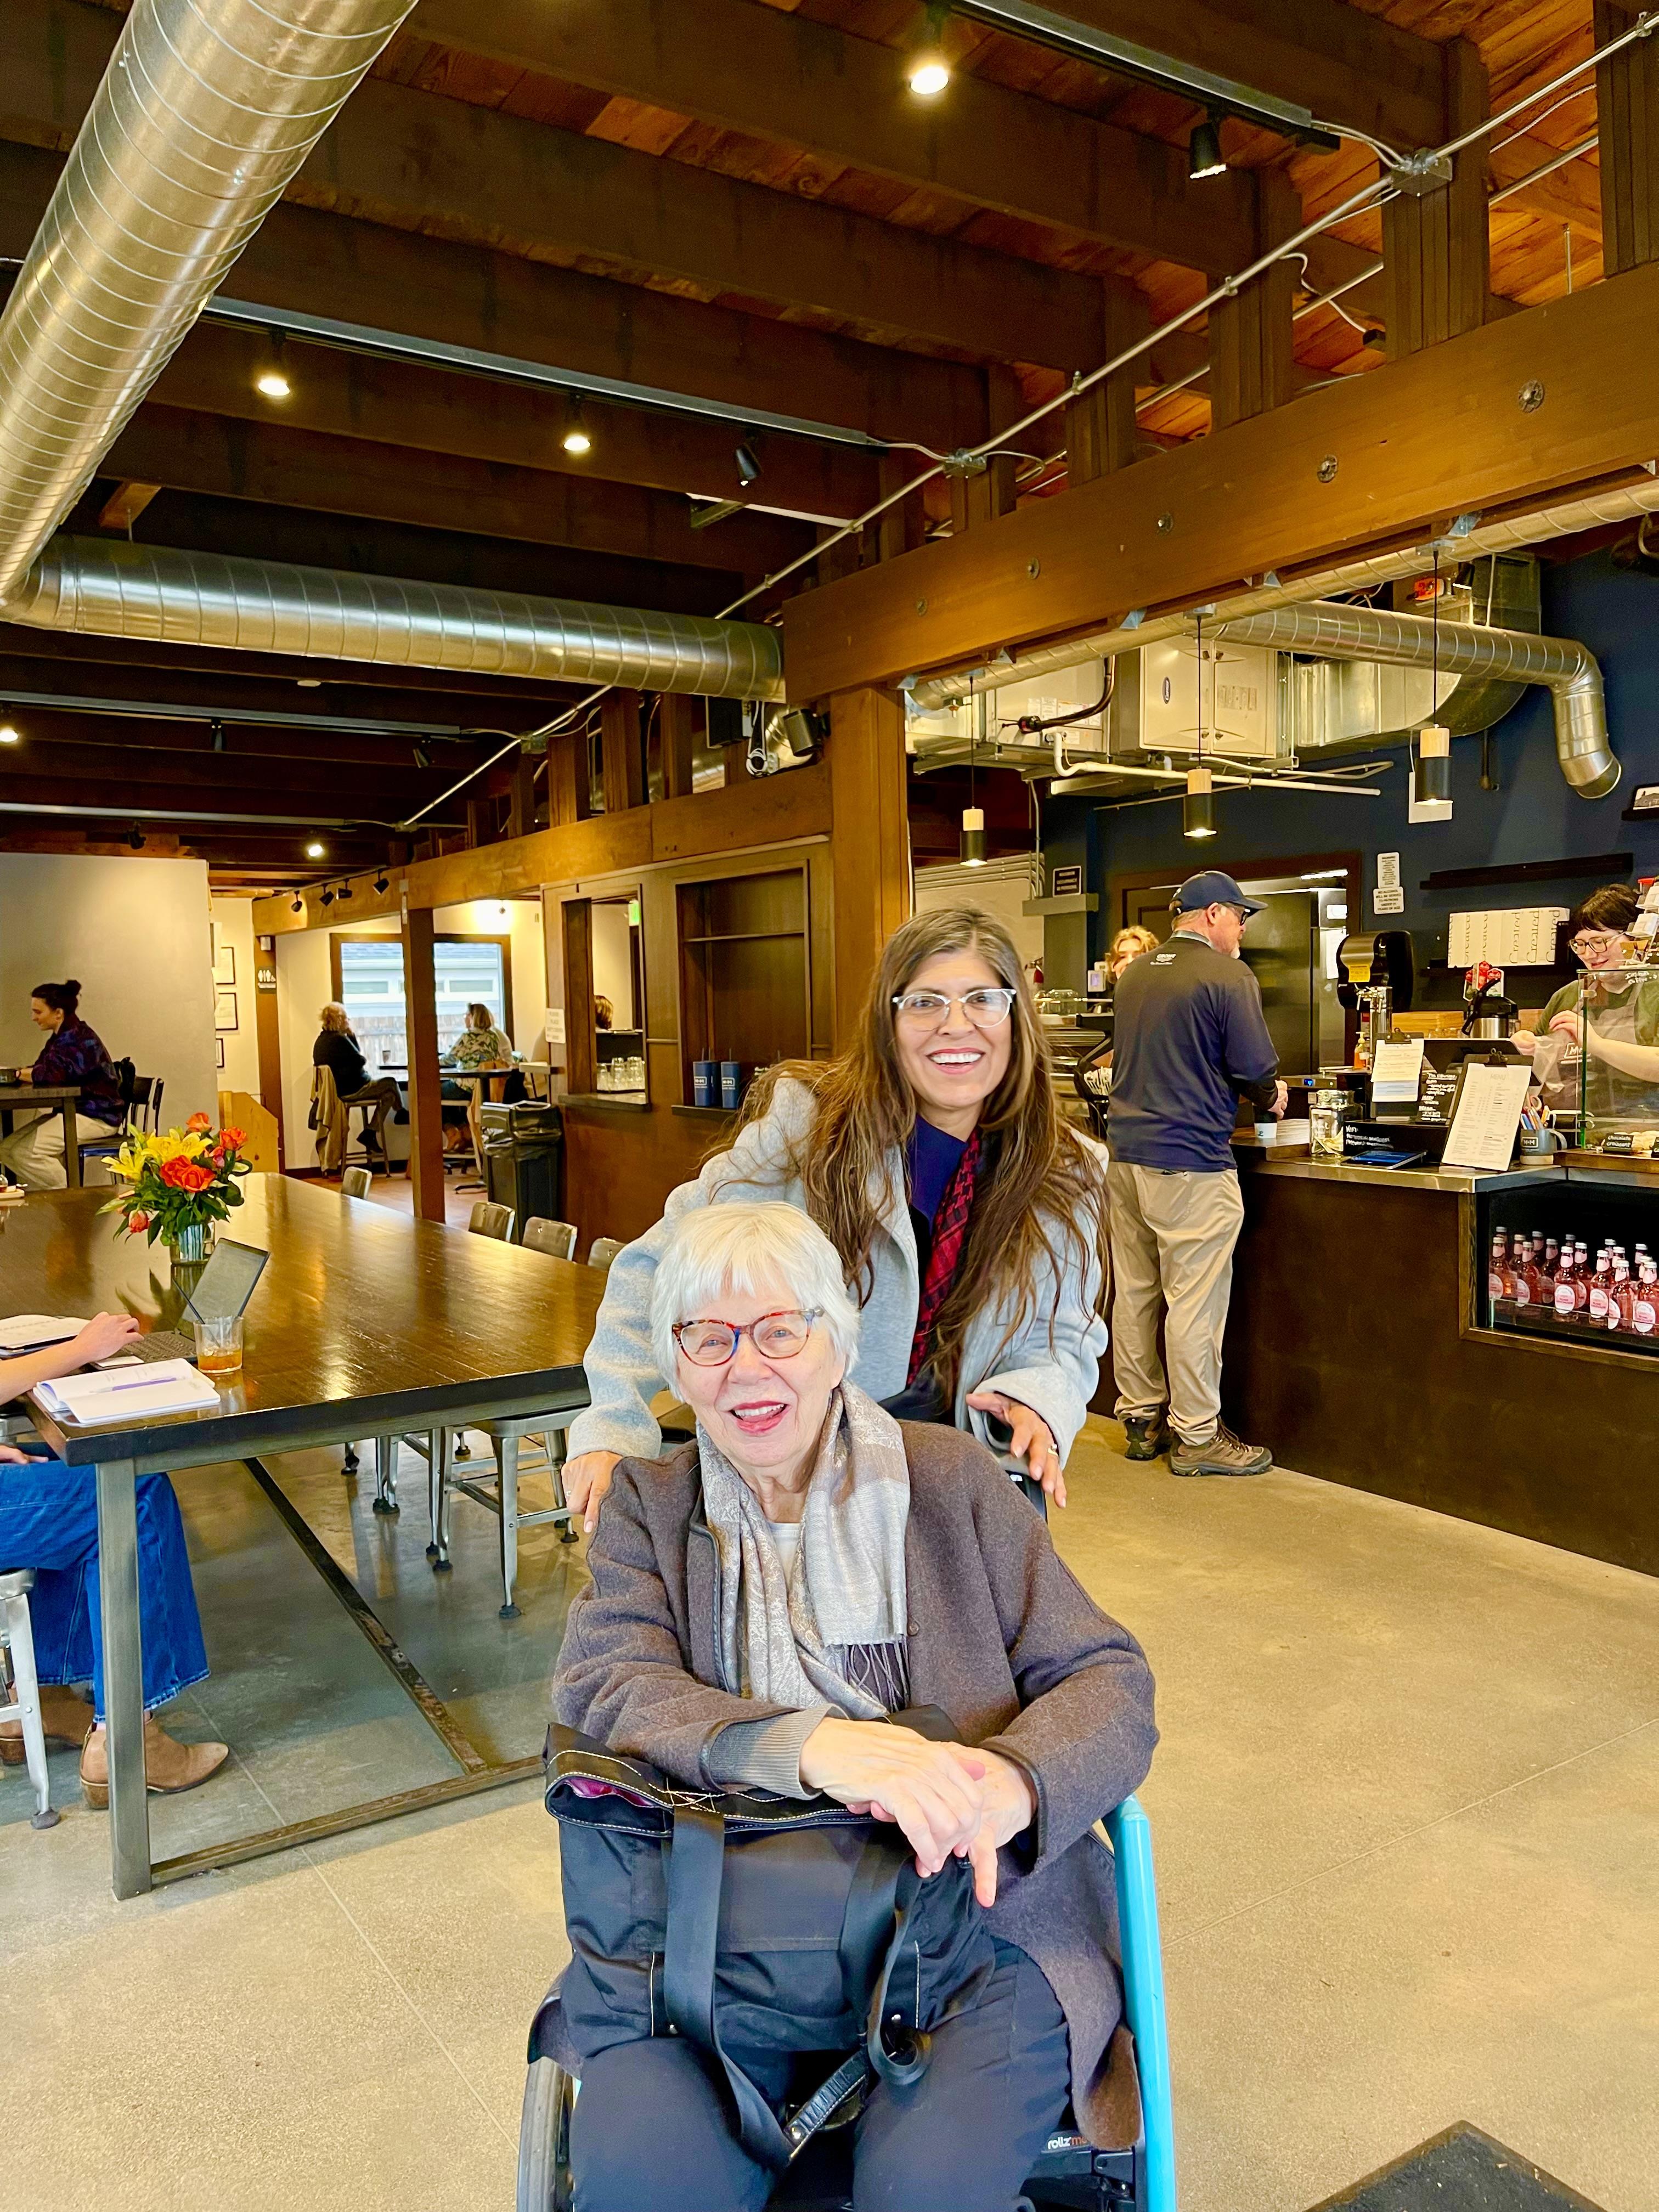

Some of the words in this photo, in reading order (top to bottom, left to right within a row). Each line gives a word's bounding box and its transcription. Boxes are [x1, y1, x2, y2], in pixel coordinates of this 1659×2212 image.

[1527, 911, 1539, 963] Created
[1545, 910, 1560, 963] Created
[1047, 2136, 1071, 2149] rollz
